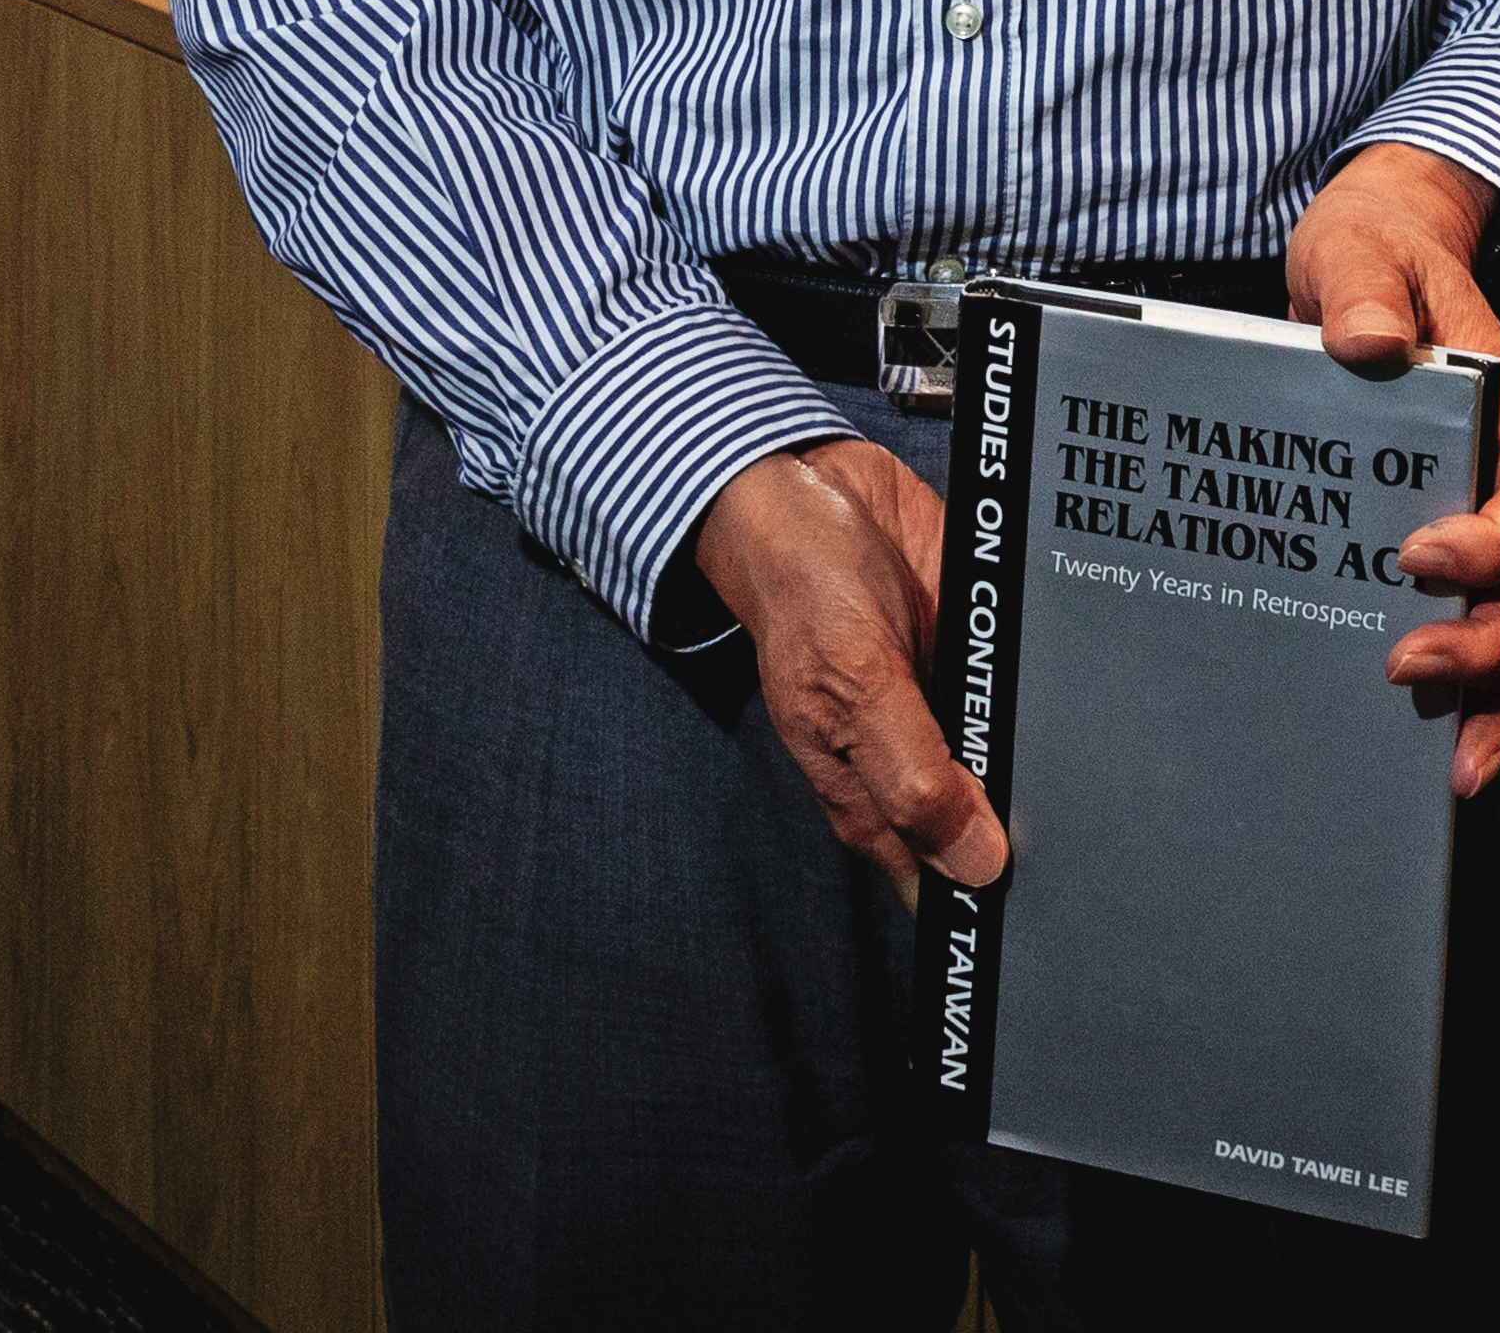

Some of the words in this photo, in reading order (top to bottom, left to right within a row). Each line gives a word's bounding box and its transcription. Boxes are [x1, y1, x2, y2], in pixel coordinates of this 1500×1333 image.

[980, 317, 1017, 481] STUDIES
[1059, 393, 1150, 446] THE
[1166, 413, 1354, 481] MAKING
[1371, 445, 1440, 492] OF
[1056, 442, 1147, 493] THE
[1161, 461, 1353, 530] TAIWAN
[973, 497, 1004, 564] ON
[1053, 490, 1319, 574] RELATIONS
[1050, 549, 1142, 594] Twenty
[1149, 568, 1213, 604] Years
[1221, 581, 1243, 607] in
[1252, 588, 1387, 634] Retrospect
[940, 928, 977, 1092] TAIWAN
[1215, 1139, 1285, 1170] DAVID
[1291, 1155, 1361, 1188] TAWEI
[1368, 1173, 1410, 1197] LEE
